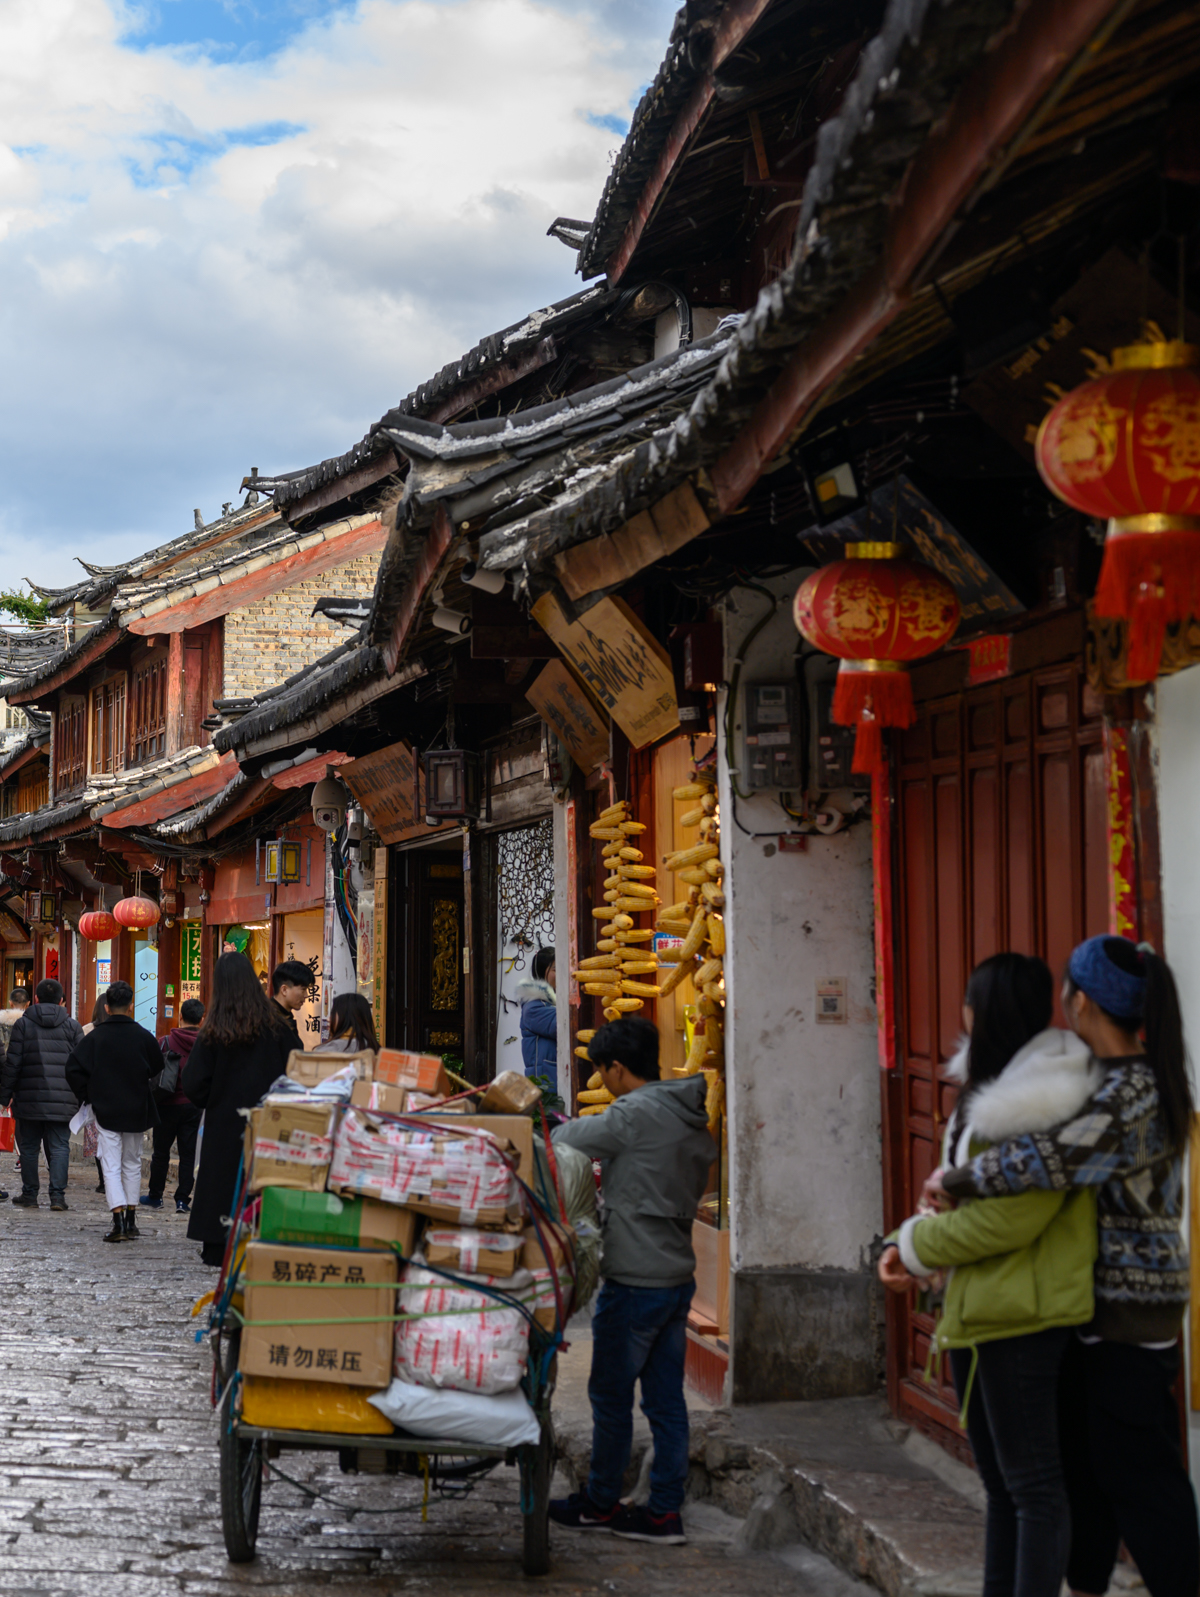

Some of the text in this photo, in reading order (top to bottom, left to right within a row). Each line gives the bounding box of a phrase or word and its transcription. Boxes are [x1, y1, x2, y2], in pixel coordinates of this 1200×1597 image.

[305, 955, 322, 1033] 花果酒
[272, 1260, 366, 1283] 易碎产品
[269, 1344, 363, 1372] 请勿踩压
